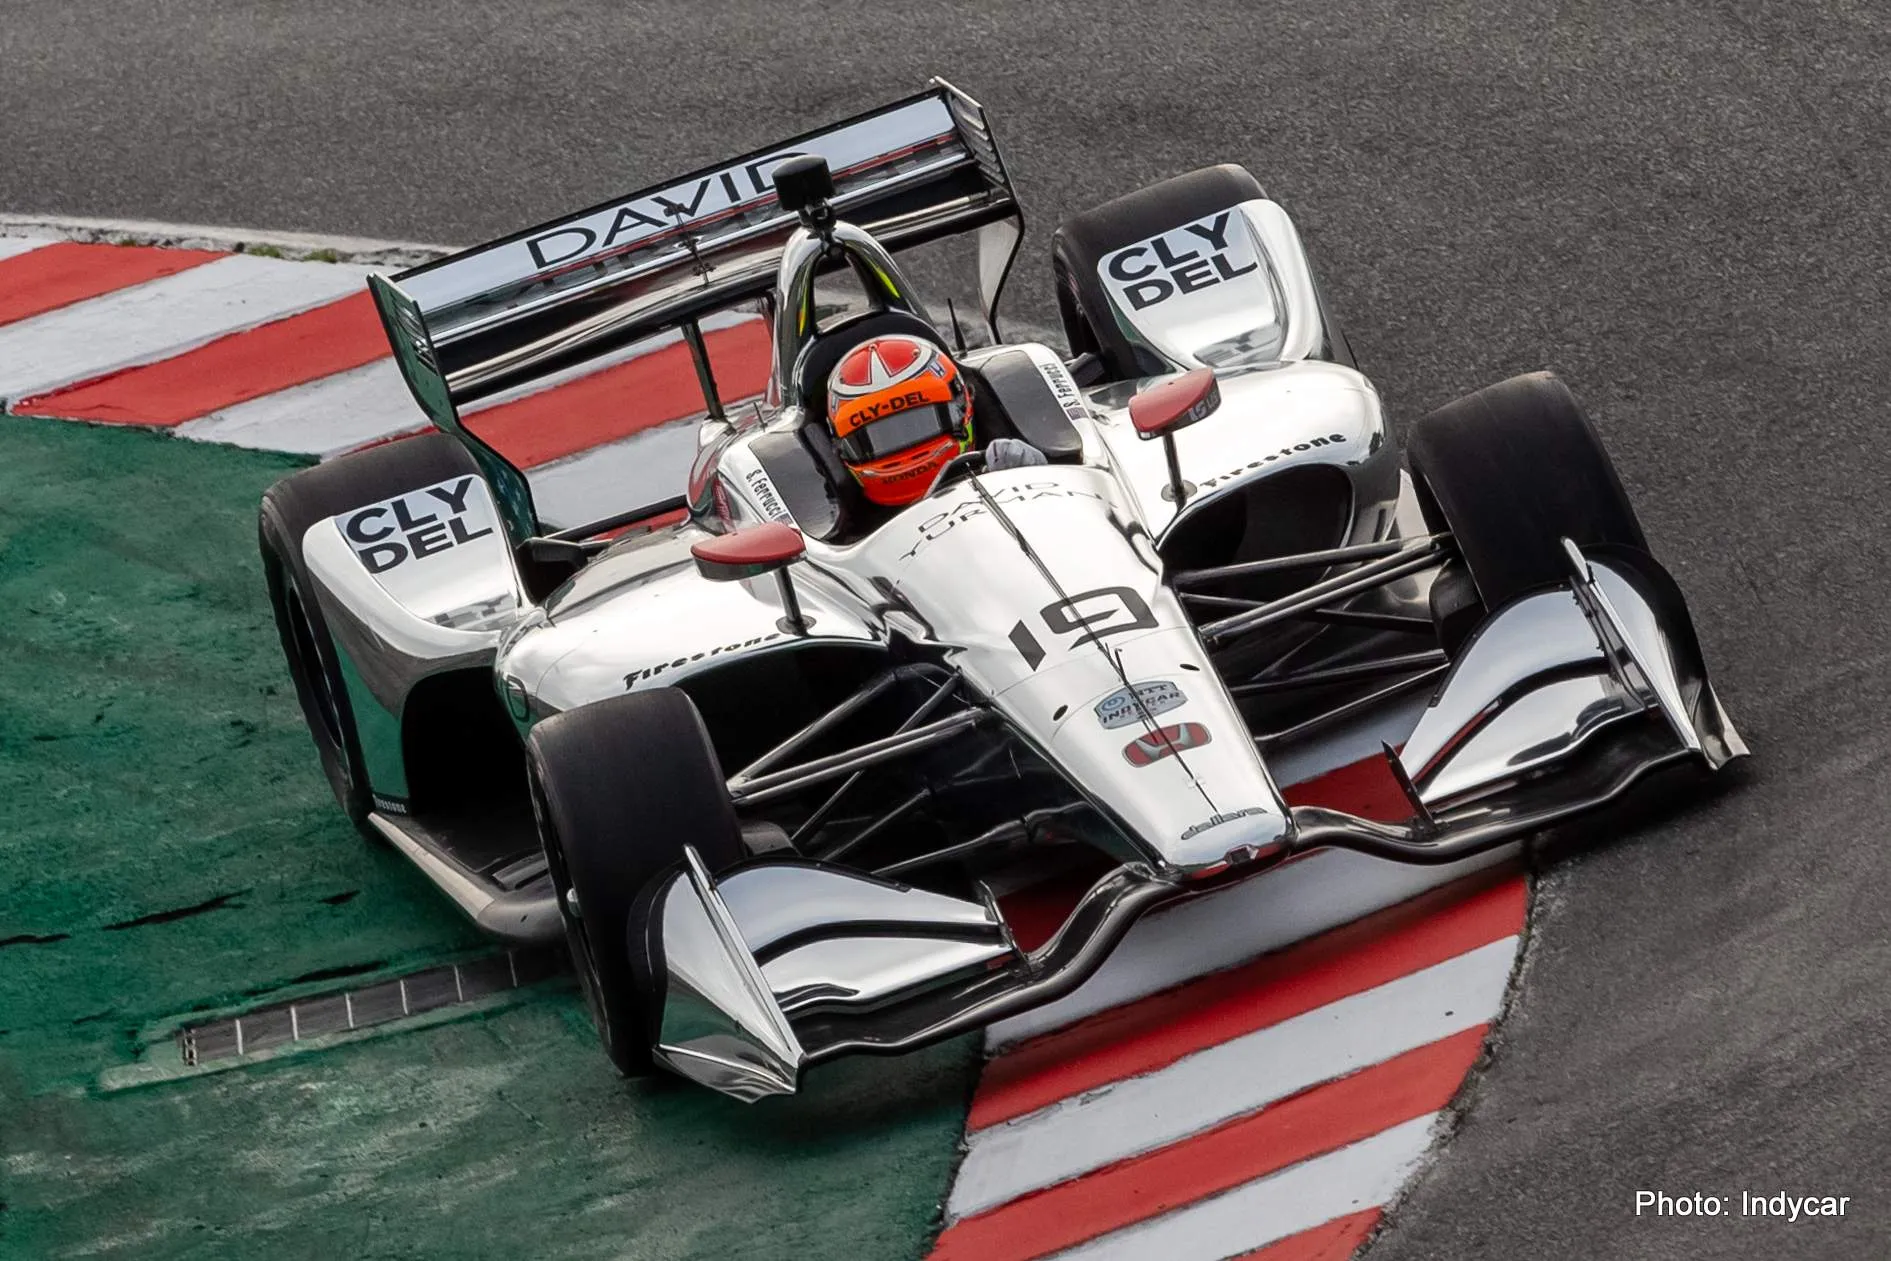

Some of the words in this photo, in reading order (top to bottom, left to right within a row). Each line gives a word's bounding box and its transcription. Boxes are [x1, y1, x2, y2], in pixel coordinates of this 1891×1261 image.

[526, 152, 808, 270] DAVID
[1109, 212, 1231, 281] CLY
[1123, 253, 1258, 311] DEL
[850, 391, 929, 427] CLY-DEL
[1199, 433, 1347, 488] Firestone
[346, 476, 474, 544] CLY
[359, 517, 494, 574] DEL
[1008, 586, 1160, 672] 19
[623, 633, 781, 691] Firestone
